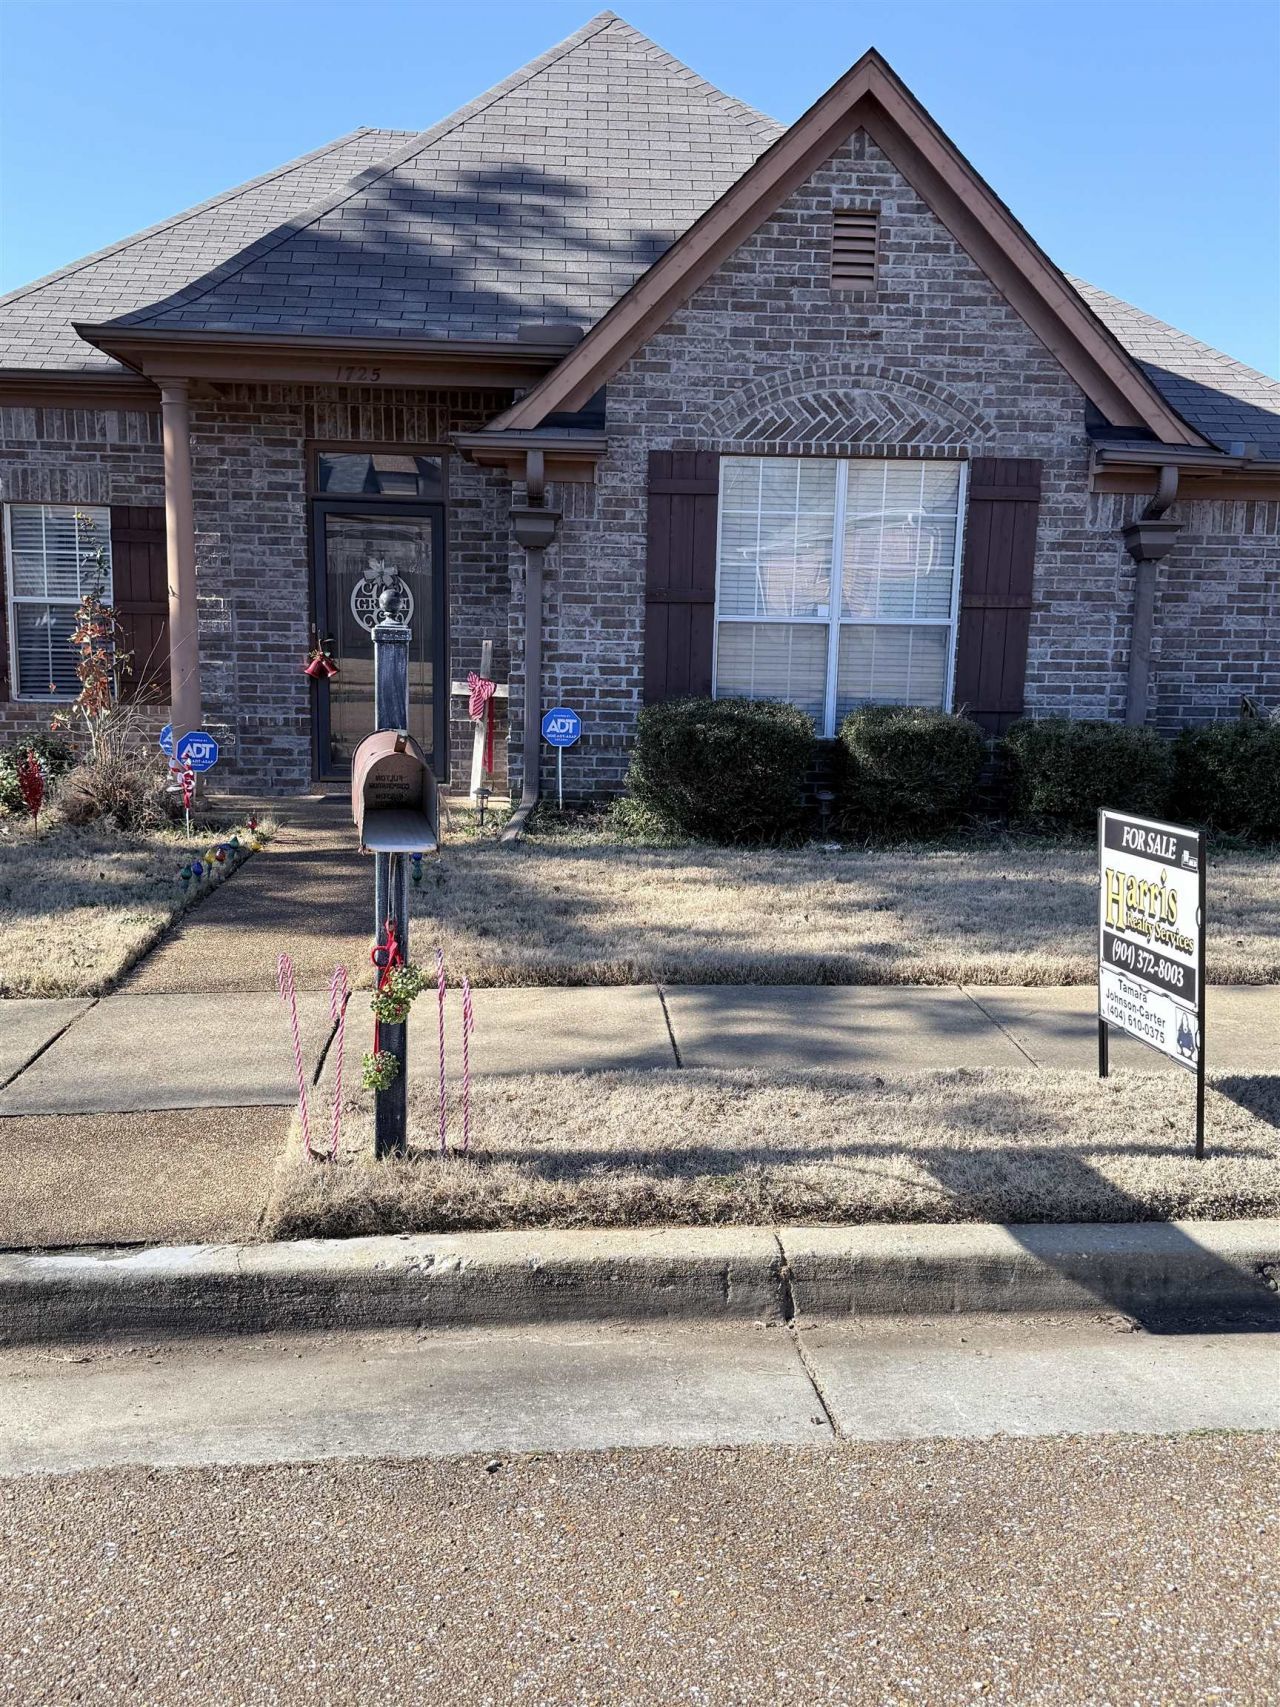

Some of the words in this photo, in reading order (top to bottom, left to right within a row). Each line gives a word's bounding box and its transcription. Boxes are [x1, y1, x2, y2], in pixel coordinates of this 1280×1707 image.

[336, 366, 382, 382] 1725
[356, 597, 410, 611] GRN
[546, 718, 578, 734] ADT
[181, 743, 215, 759] ADT
[1122, 826, 1145, 851] FOR
[1146, 832, 1177, 860] SALE
[1105, 866, 1178, 931] Harris
[1126, 911, 1155, 942] Realty
[1154, 922, 1195, 955] Services
[1112, 937, 1135, 970] (901)
[1136, 949, 1184, 987] 372-8003
[1118, 978, 1148, 1003] Tamara
[1105, 988, 1166, 1029] Johnson-Carter
[1107, 1002, 1126, 1025] (404)
[1127, 1013, 1165, 1044] 610-0375
